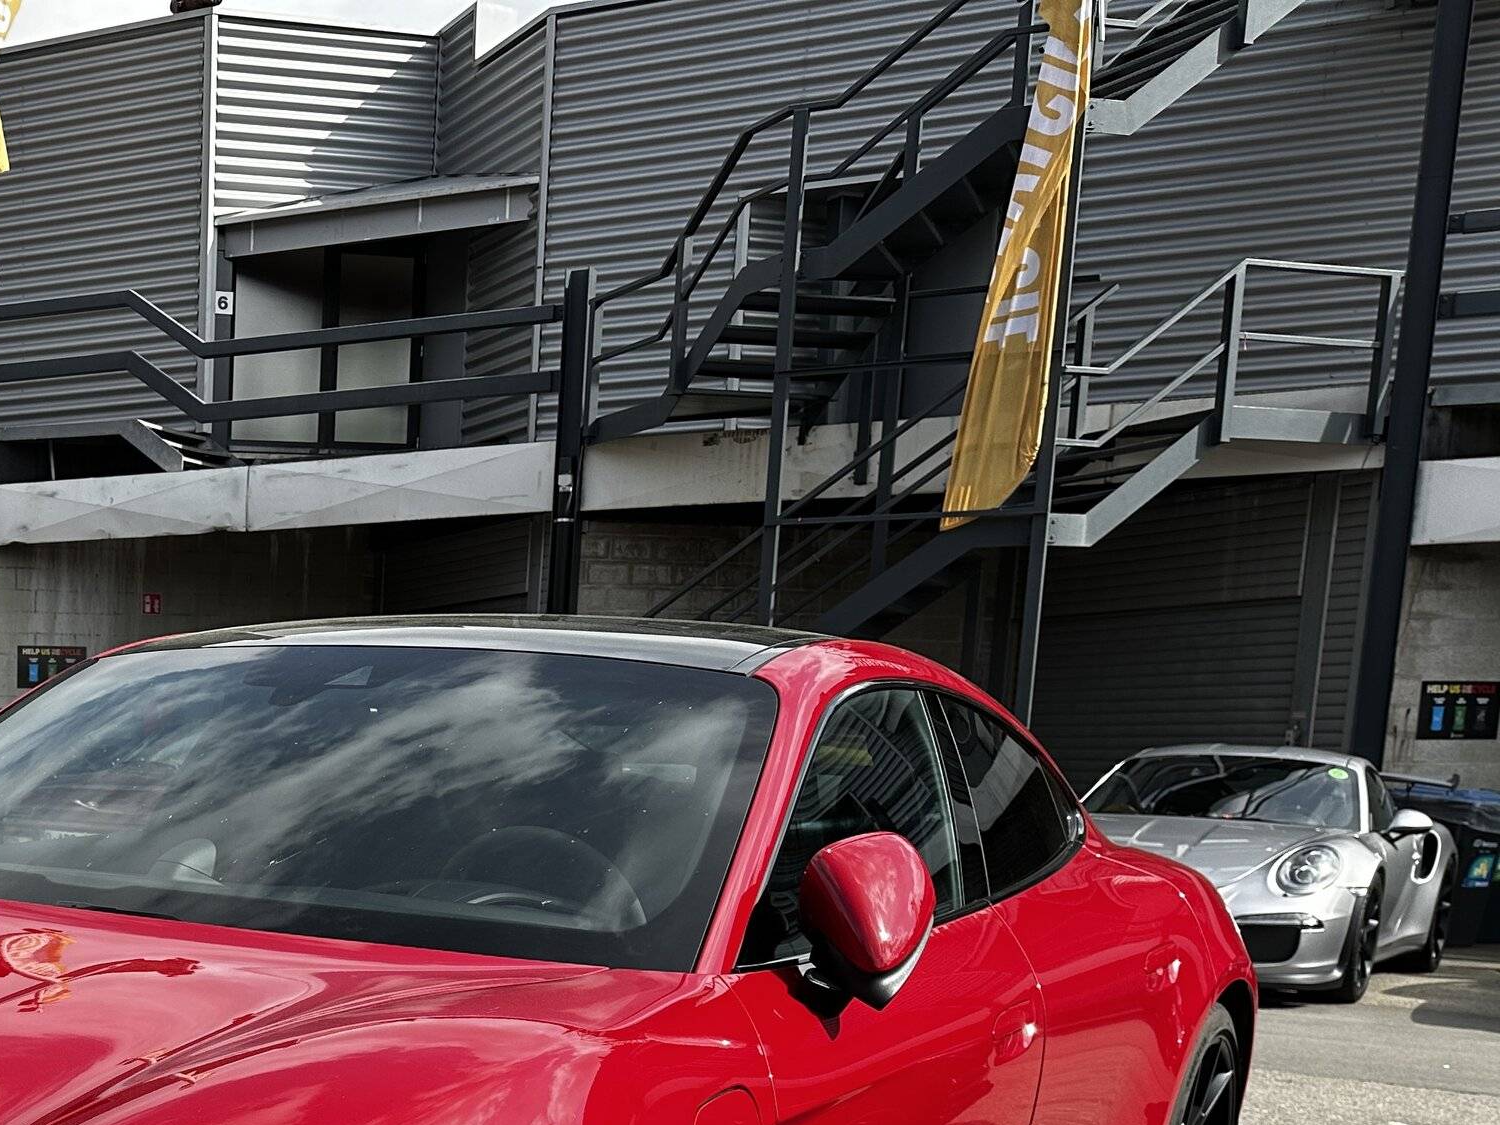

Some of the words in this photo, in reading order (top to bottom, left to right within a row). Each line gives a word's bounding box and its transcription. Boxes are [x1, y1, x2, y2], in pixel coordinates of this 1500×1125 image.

[218, 296, 228, 310] 6
[1426, 684, 1448, 694] HELP
[1449, 684, 1460, 694] US
